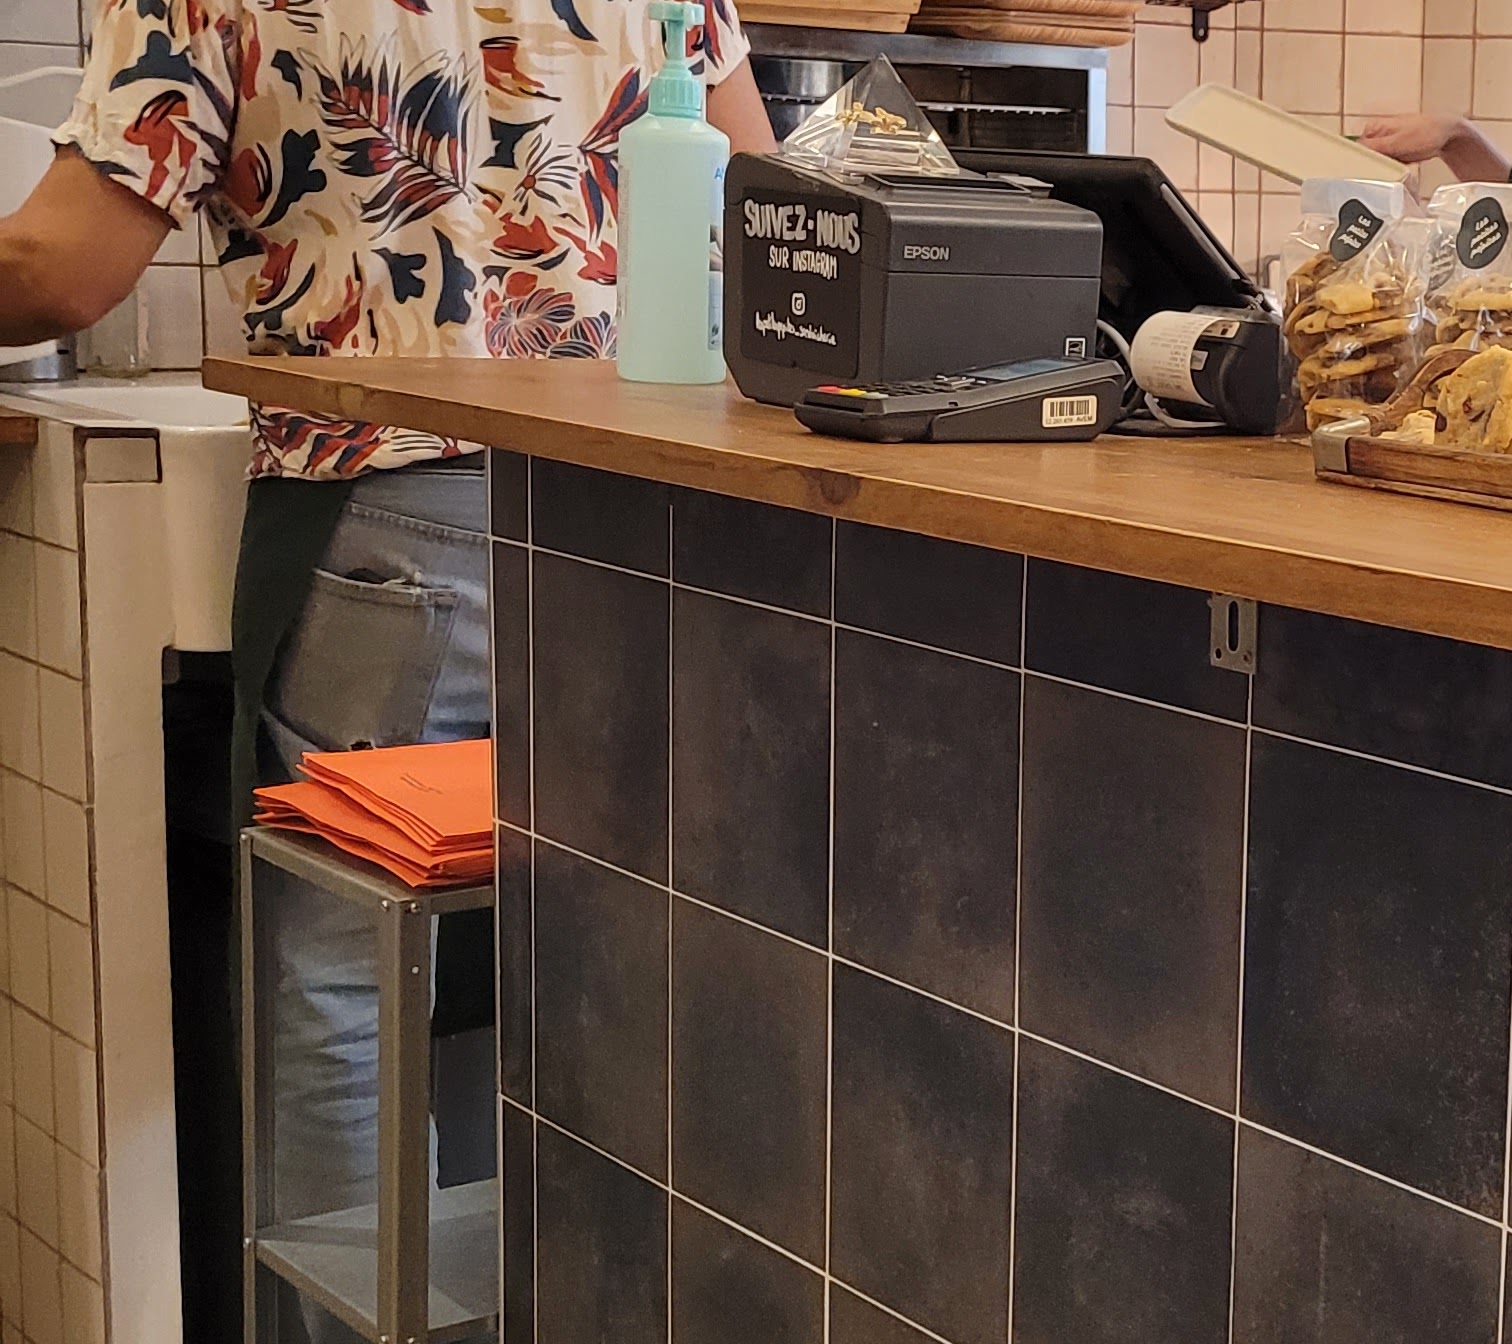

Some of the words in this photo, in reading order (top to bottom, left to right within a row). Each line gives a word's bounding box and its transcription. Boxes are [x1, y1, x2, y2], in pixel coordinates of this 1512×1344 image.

[769, 244, 790, 268] SUR
[792, 249, 838, 280] INSTAGRAM
[903, 244, 950, 261] EPSON
